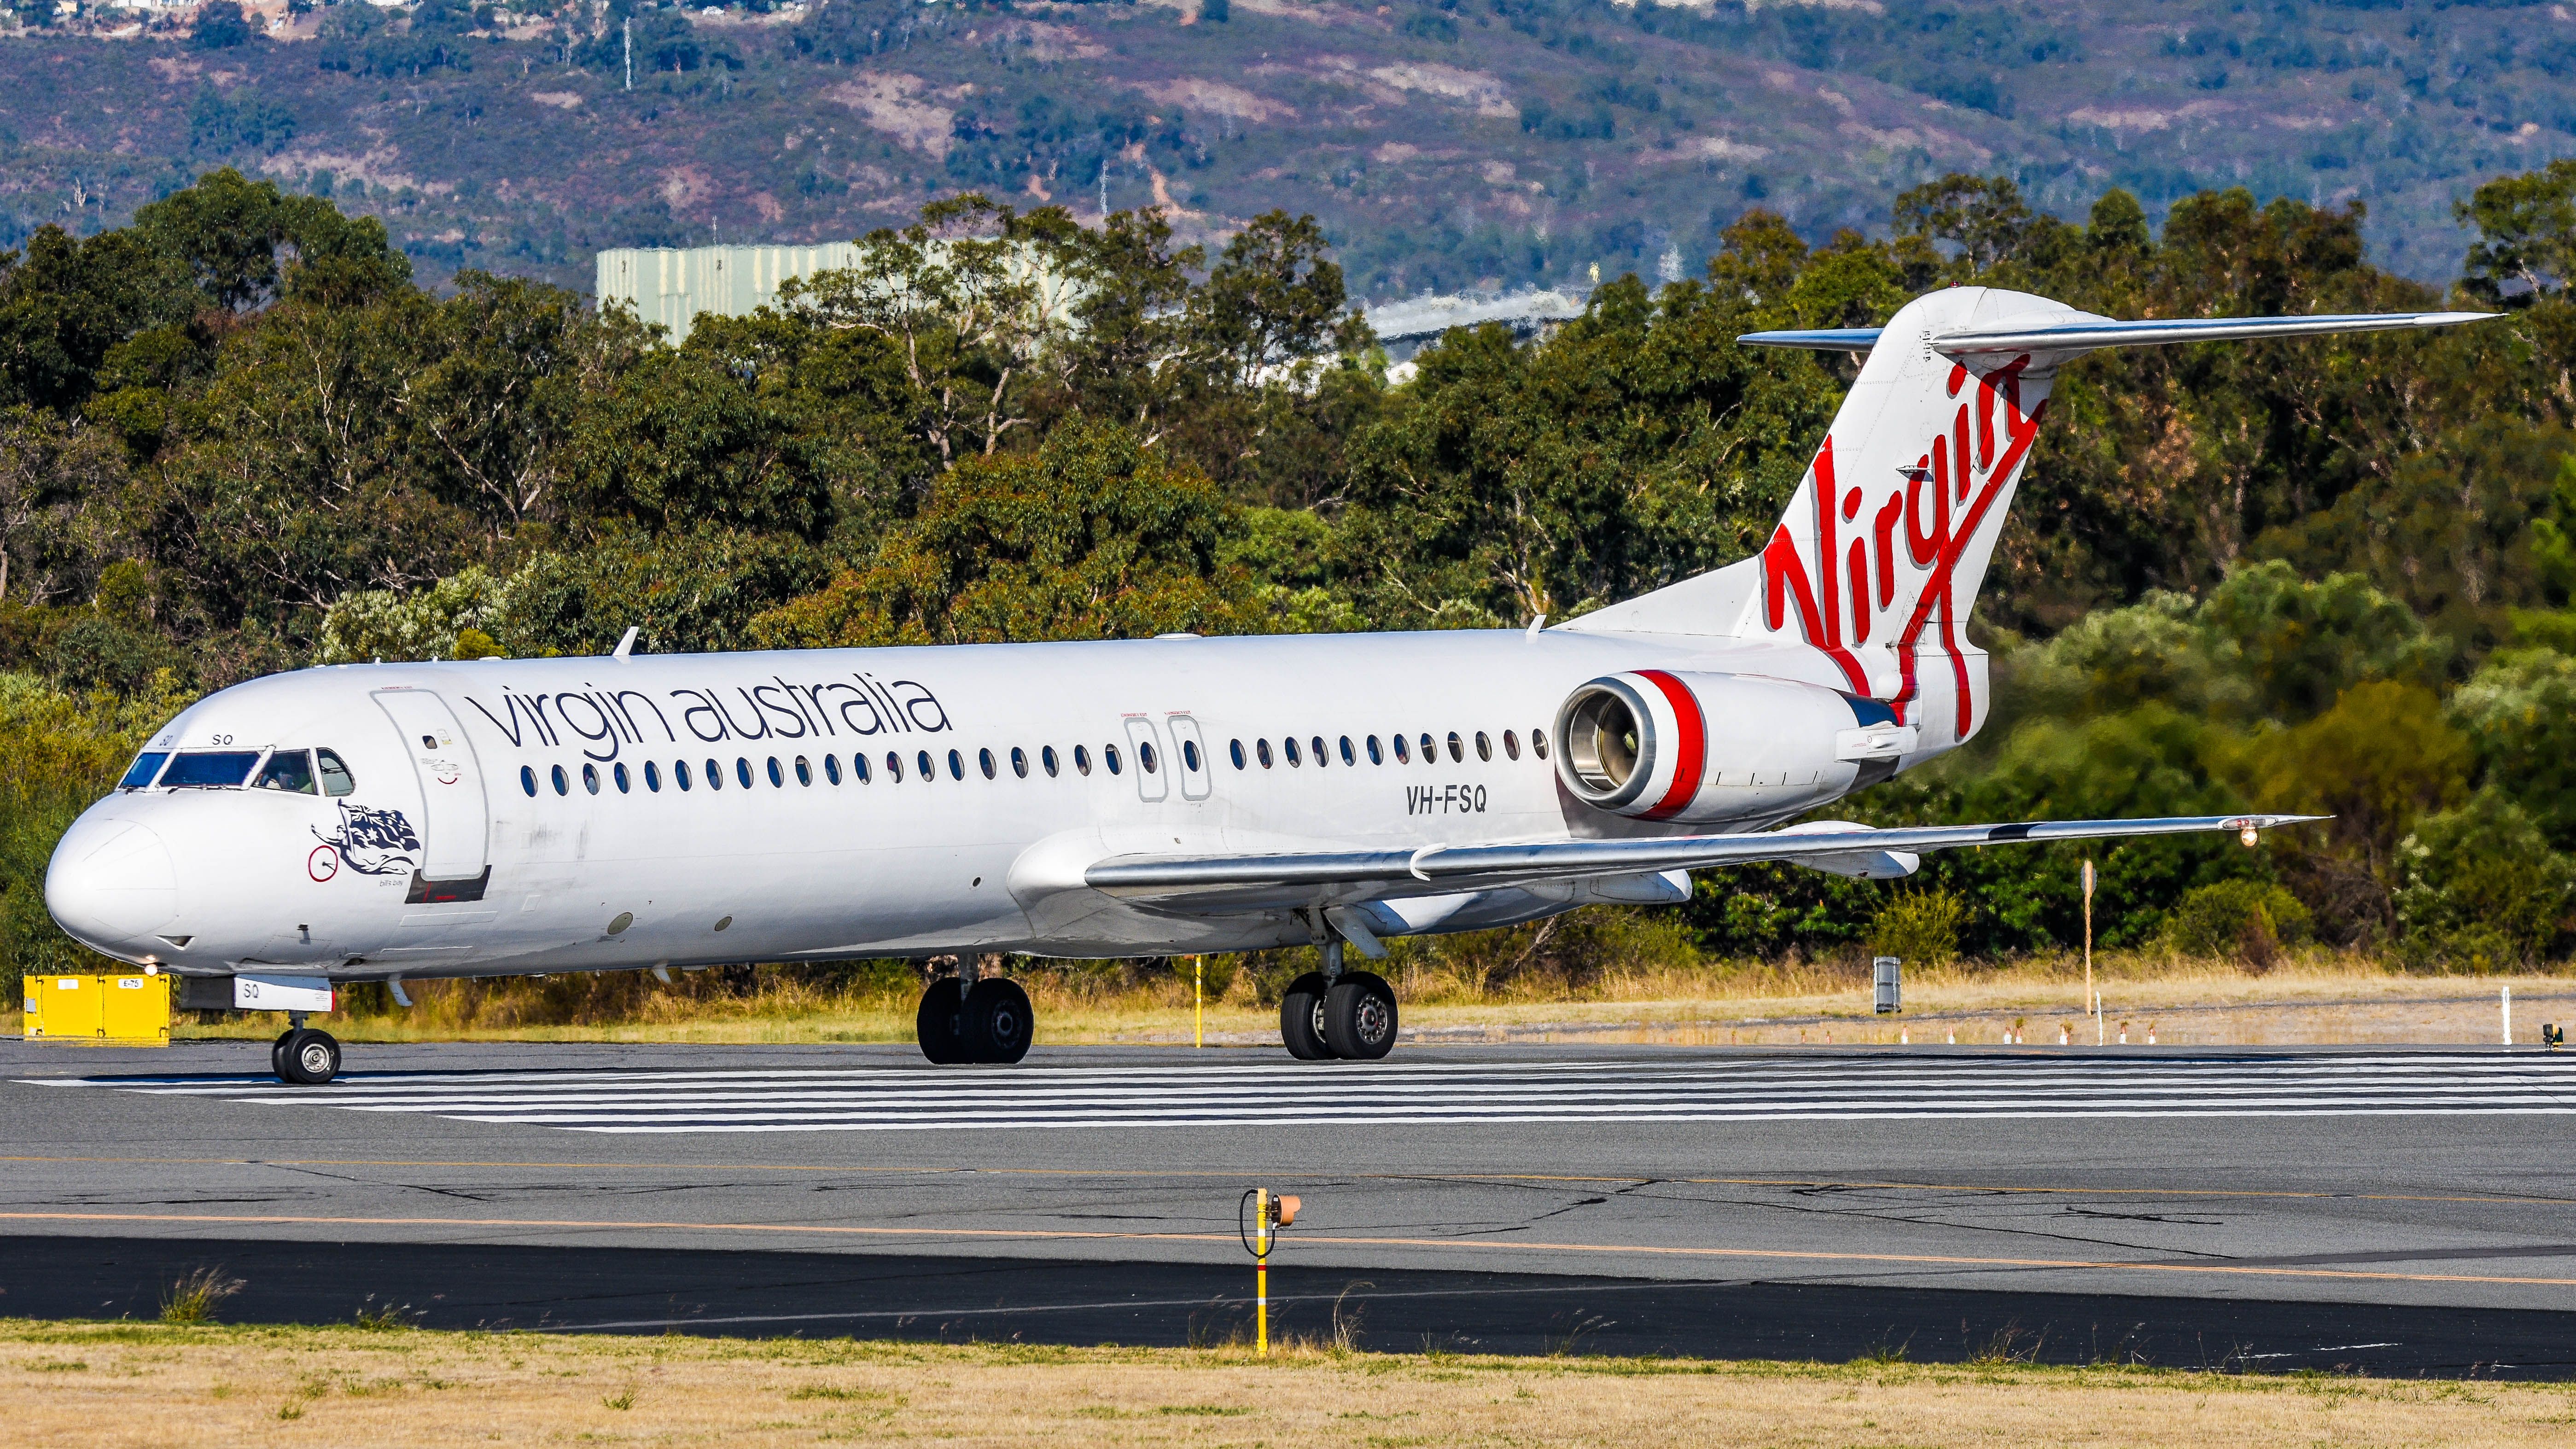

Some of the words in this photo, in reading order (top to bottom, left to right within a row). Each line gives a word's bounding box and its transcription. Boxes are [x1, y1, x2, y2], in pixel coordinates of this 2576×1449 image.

[1760, 353, 2048, 740] Virgin
[464, 682, 676, 762] virgin
[670, 672, 953, 742] australia
[212, 734, 233, 745] SQ
[1406, 784, 1487, 815] VH-FSQ
[244, 983, 259, 998] SQ
